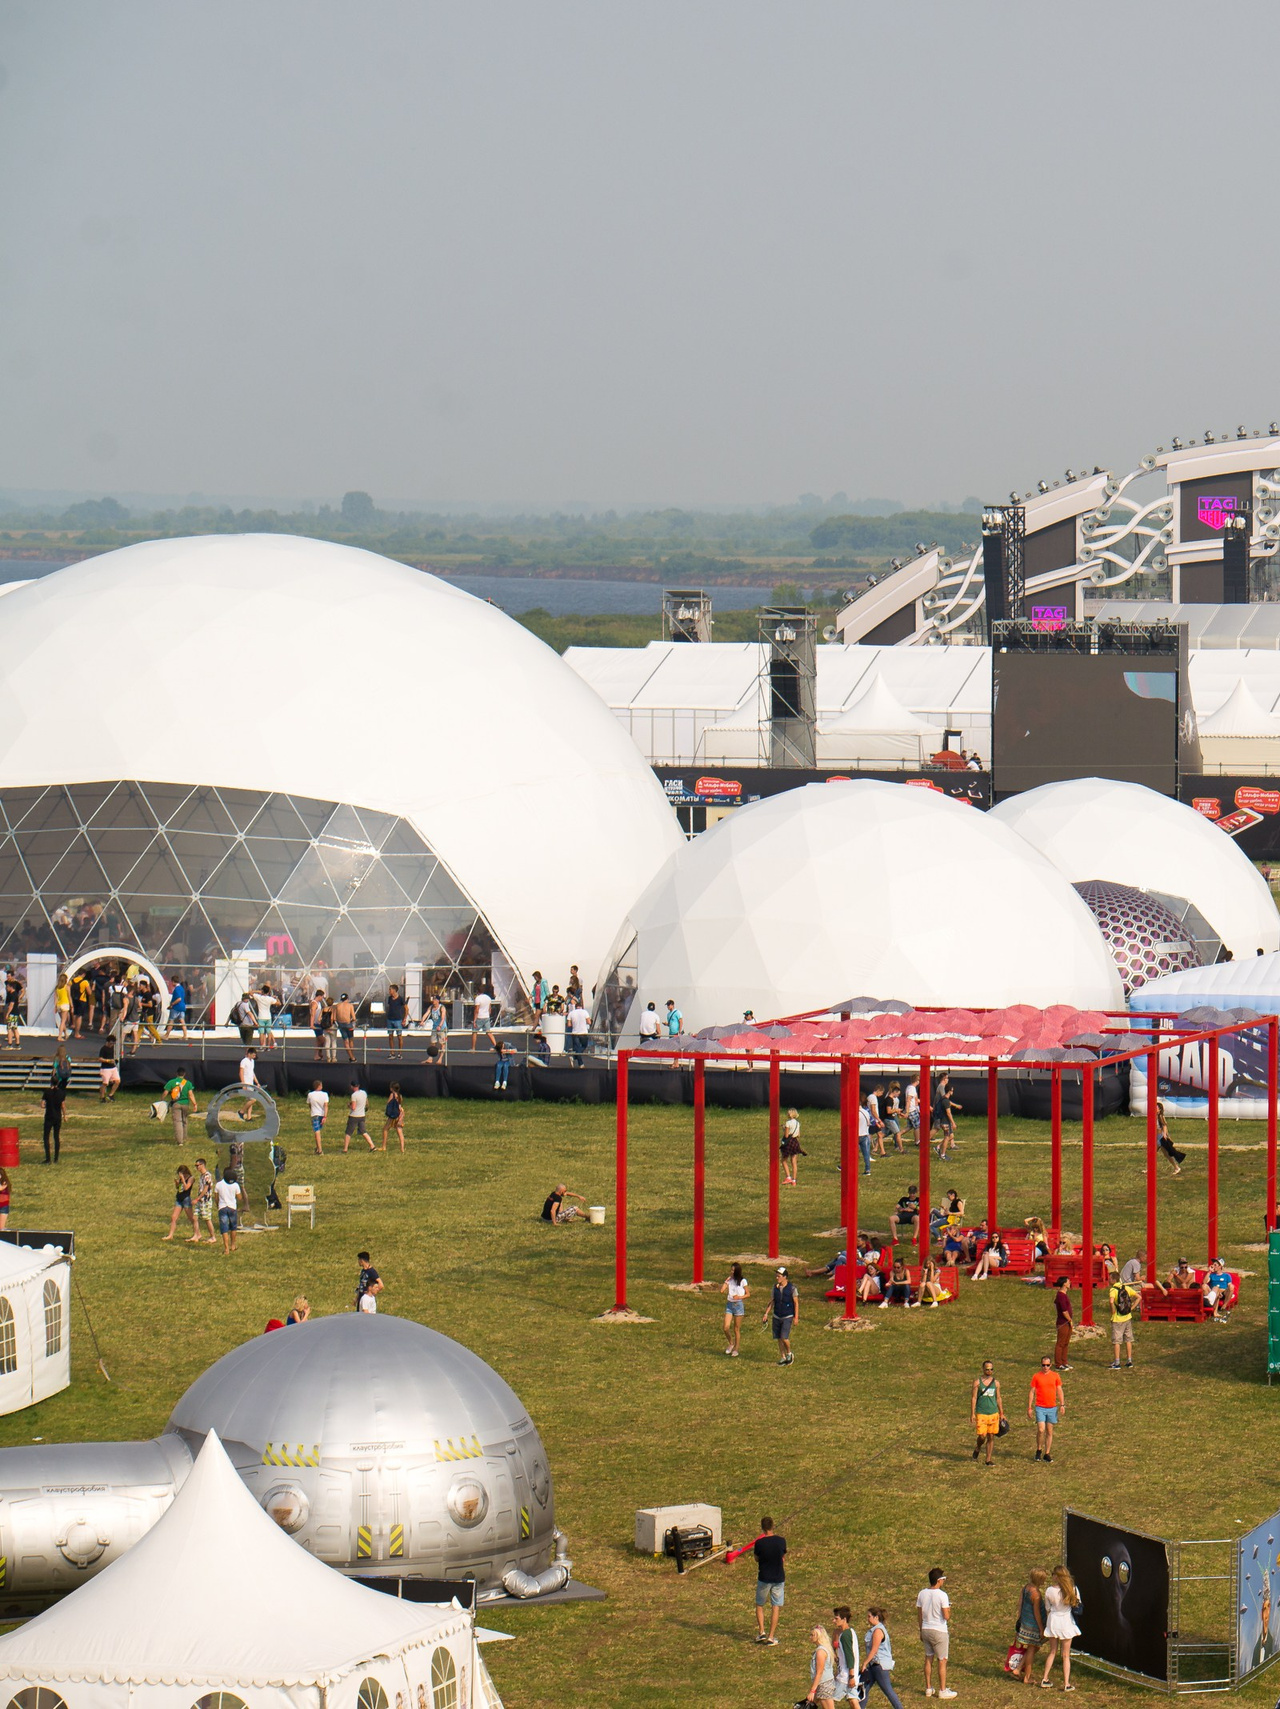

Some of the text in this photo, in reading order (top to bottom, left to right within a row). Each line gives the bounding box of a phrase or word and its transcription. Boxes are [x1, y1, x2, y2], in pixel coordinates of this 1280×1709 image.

[1201, 499, 1234, 510] TAG
[1035, 608, 1064, 618] TAG
[1157, 1034, 1236, 1097] RAID
[353, 1442, 404, 1453] клаустрофобия
[46, 1484, 106, 1496] клаустрофобия
